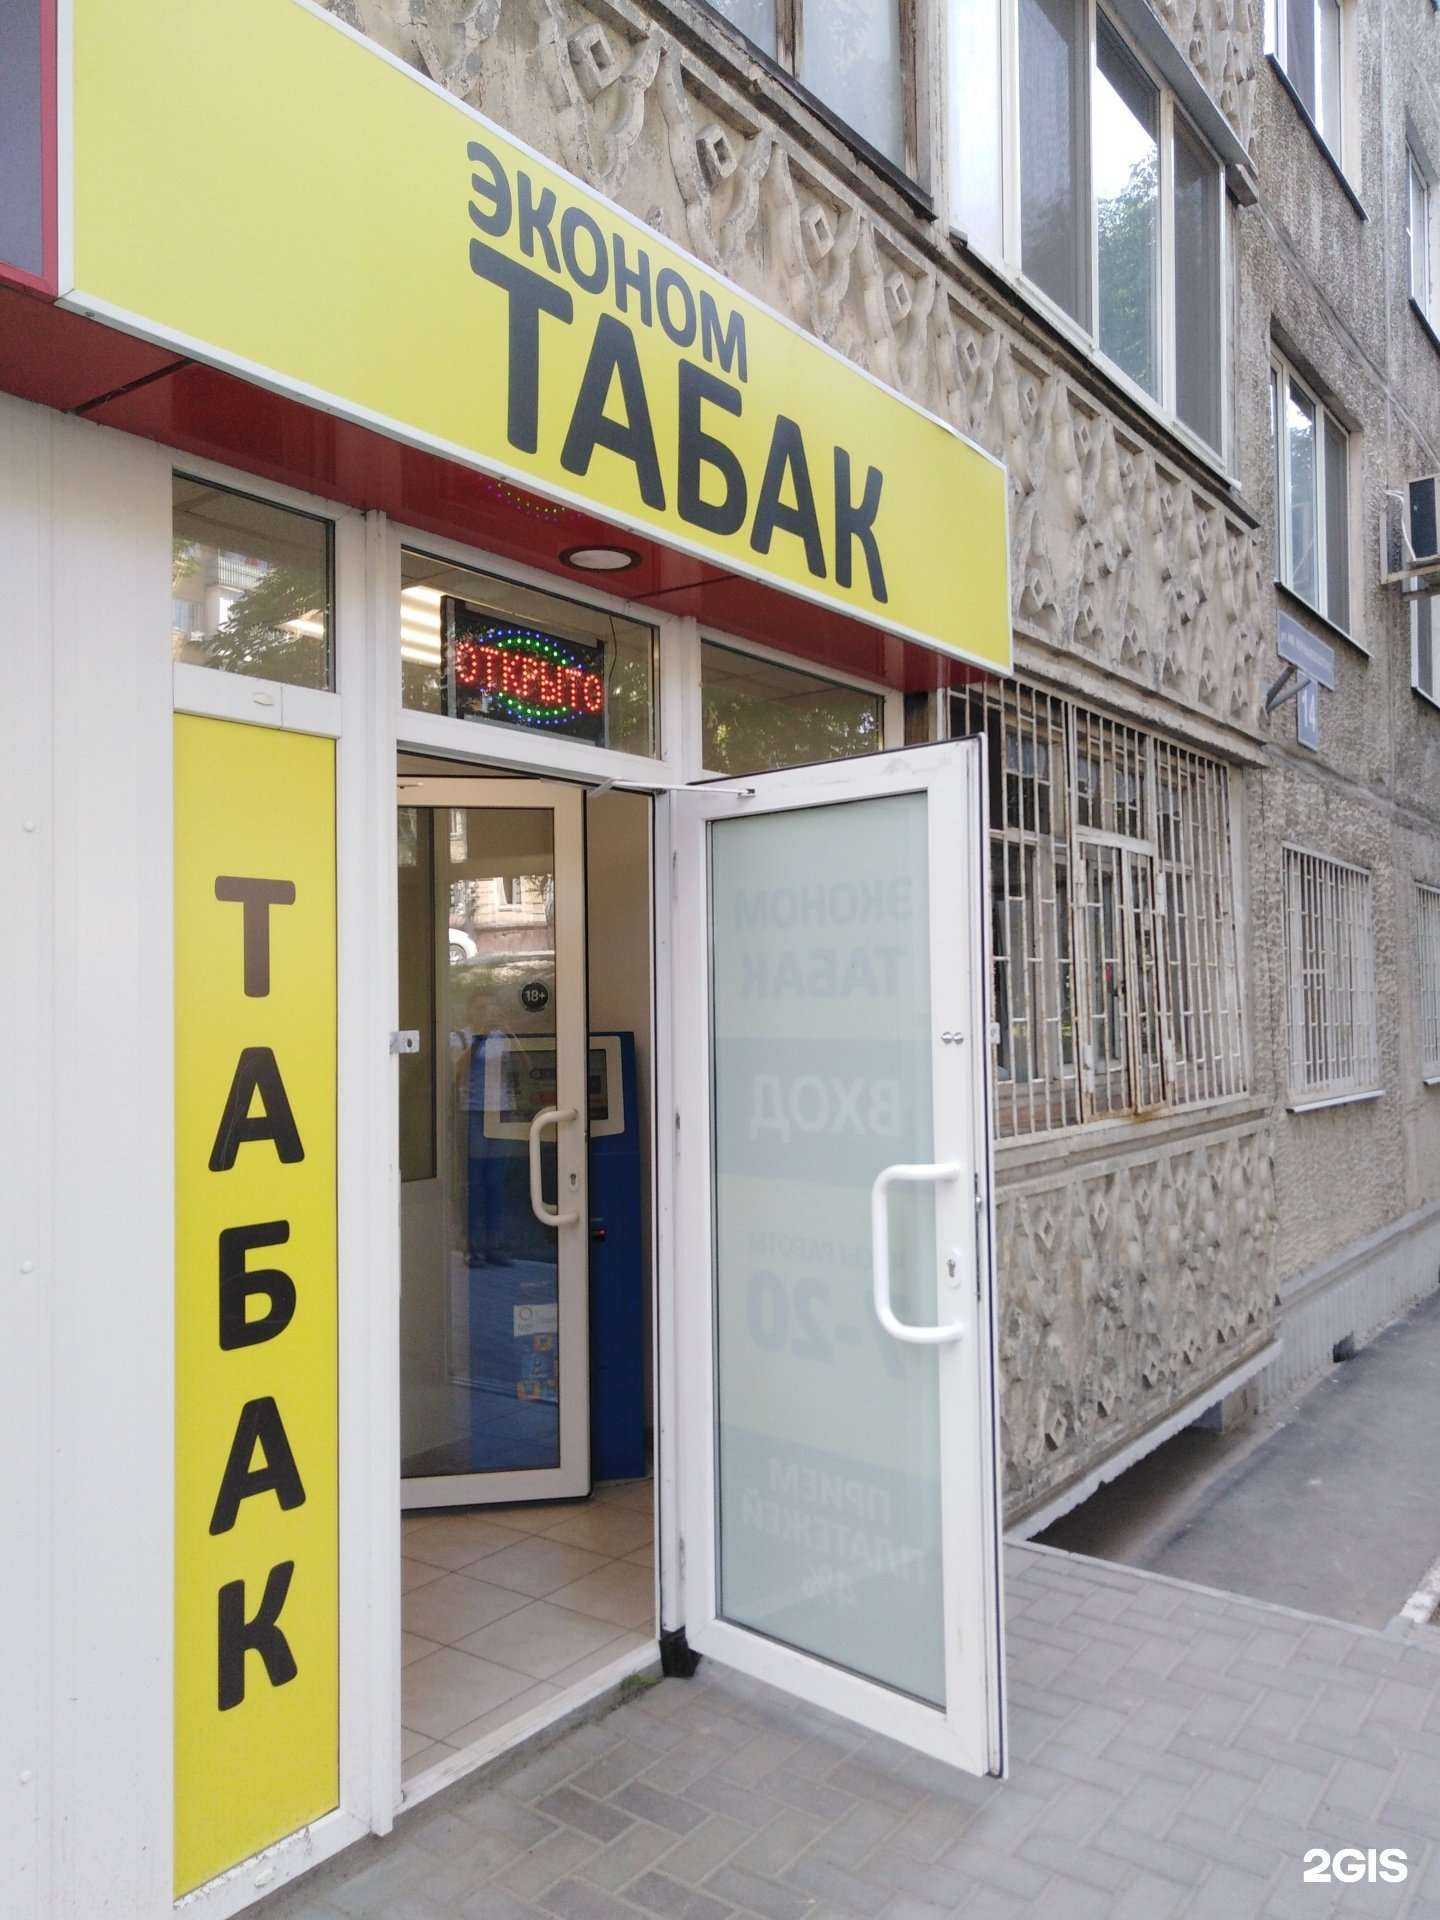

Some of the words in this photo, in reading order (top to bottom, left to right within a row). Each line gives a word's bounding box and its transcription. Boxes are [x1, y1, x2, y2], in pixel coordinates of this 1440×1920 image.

[467, 141, 748, 383] ЭКОНОМ
[469, 238, 888, 604] ТАБАК
[455, 642, 602, 712] ОТКРЫТО
[524, 988, 546, 1002] 18+
[208, 876, 306, 1711] ТАБАК
